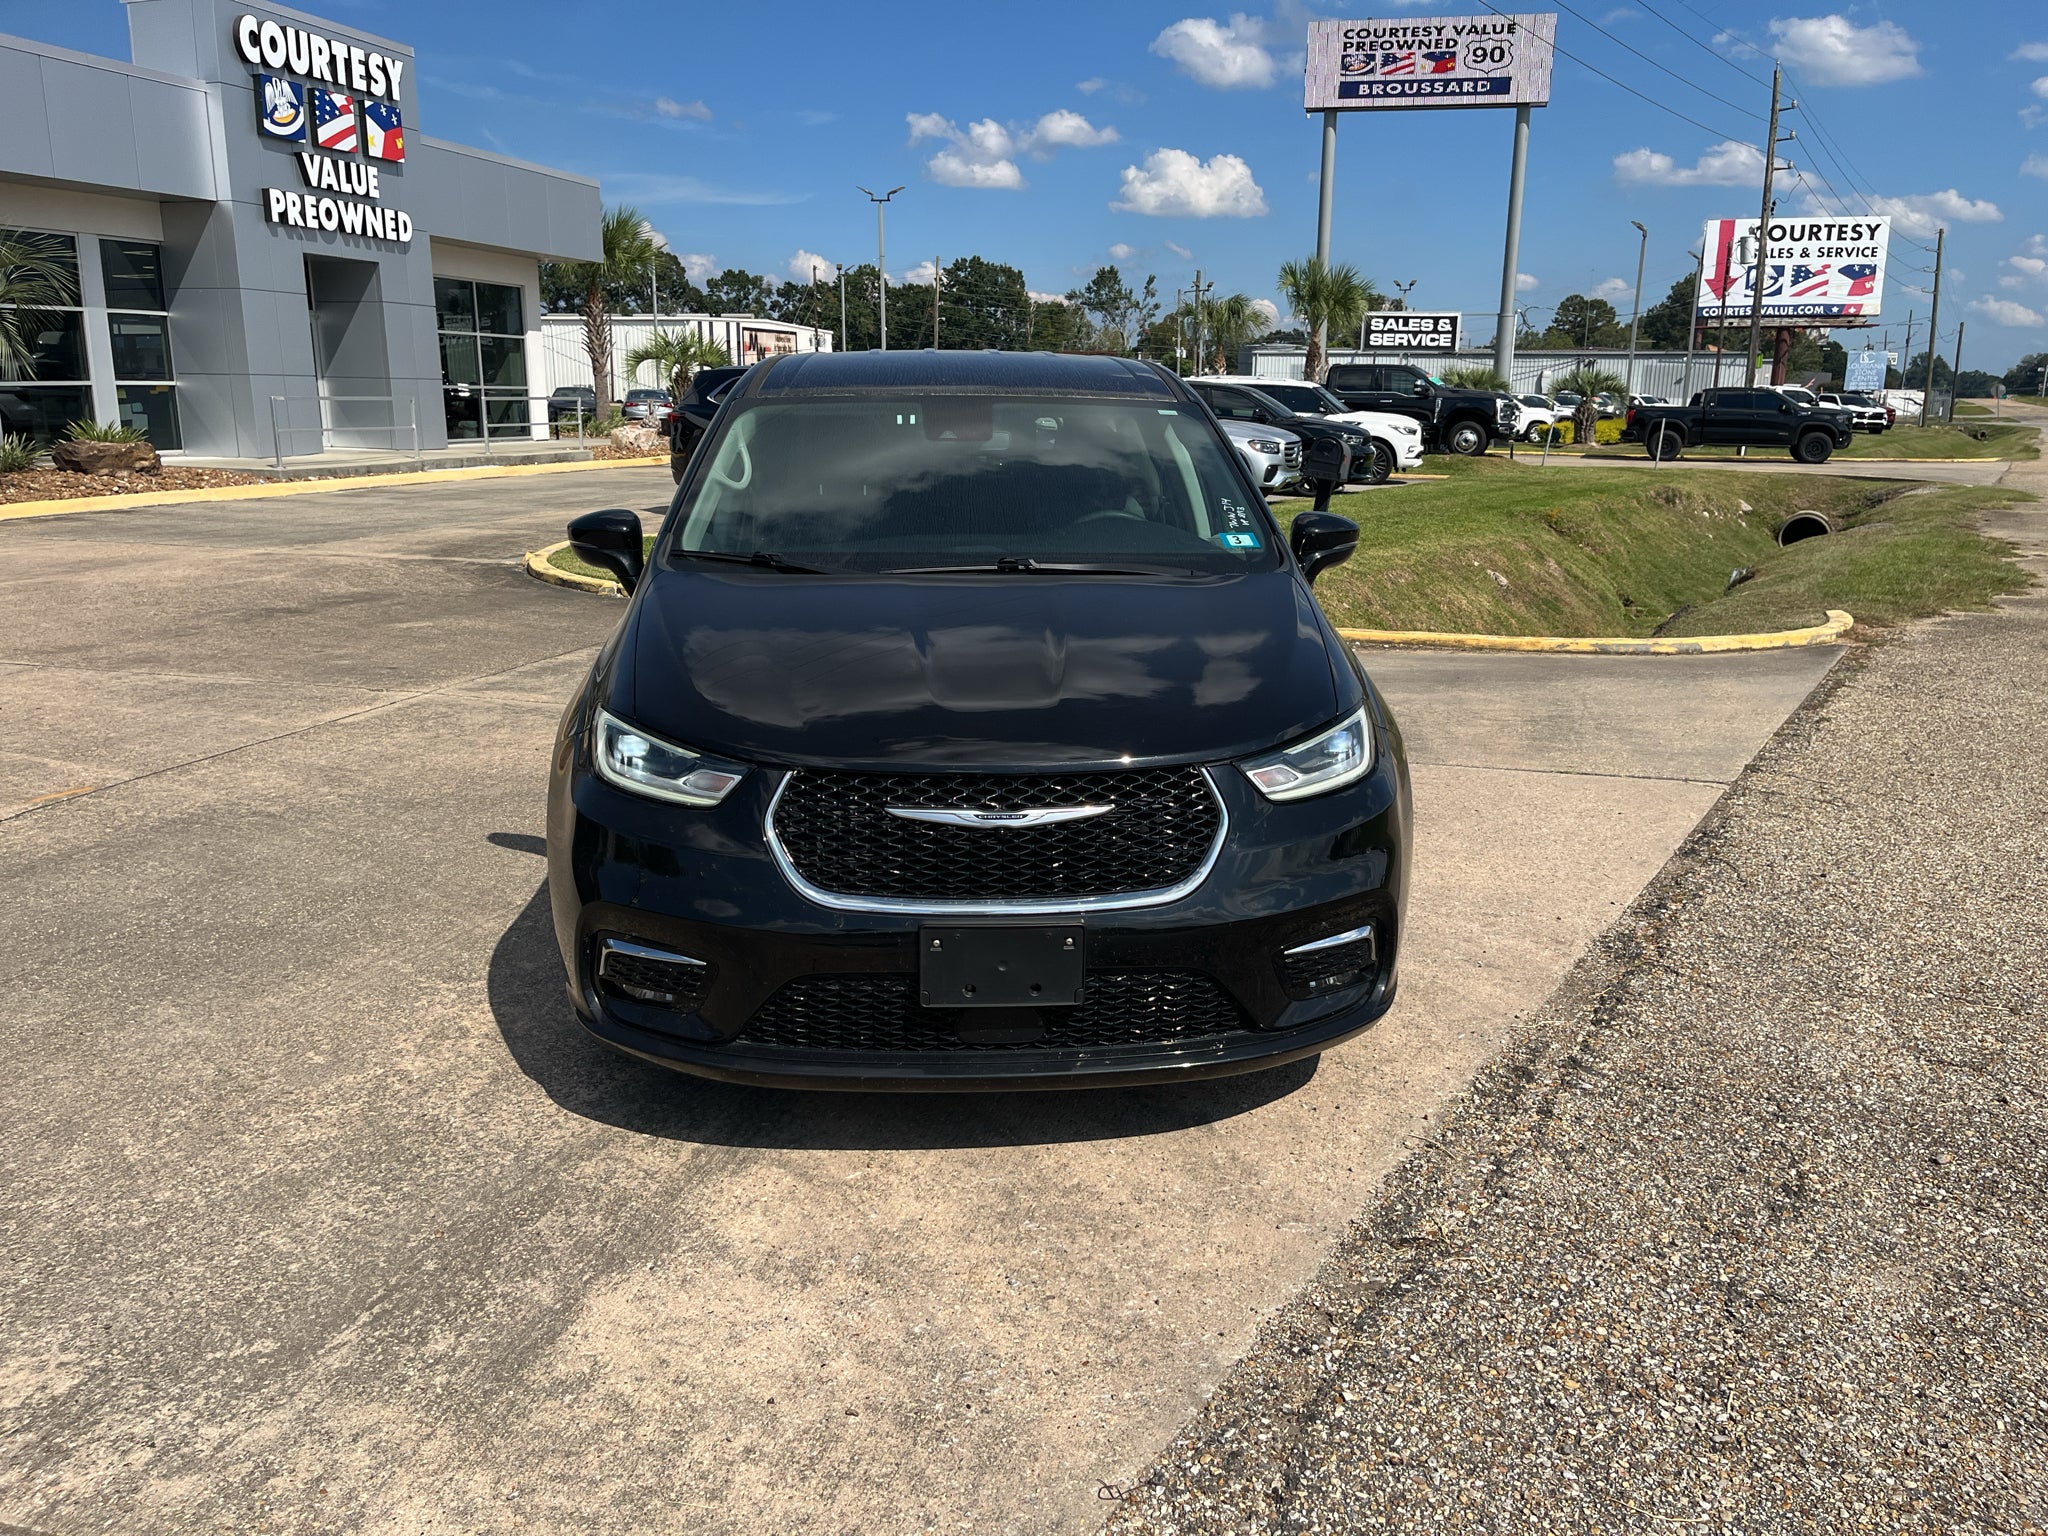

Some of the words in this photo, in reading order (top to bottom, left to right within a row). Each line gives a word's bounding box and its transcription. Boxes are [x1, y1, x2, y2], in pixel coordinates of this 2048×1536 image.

[1343, 26, 1446, 39] COURTESY
[1452, 22, 1517, 36] VALUE
[1343, 38, 1458, 51] PREOWNED
[238, 14, 404, 101] COURTESY
[1471, 46, 1506, 64] 90
[1358, 80, 1491, 96] BROUSSARD
[302, 152, 380, 198] VALUE
[269, 187, 413, 242] PREOWNED
[1753, 247, 1794, 259] LES
[1799, 248, 1810, 258] &
[1817, 246, 1878, 258] SERVICE
[1702, 305, 1824, 317] CORTESVALUE.COM
[1370, 318, 1434, 331] SALES
[1437, 318, 1453, 331] &
[1369, 333, 1452, 347] SERVICE
[1232, 535, 1242, 544] 3
